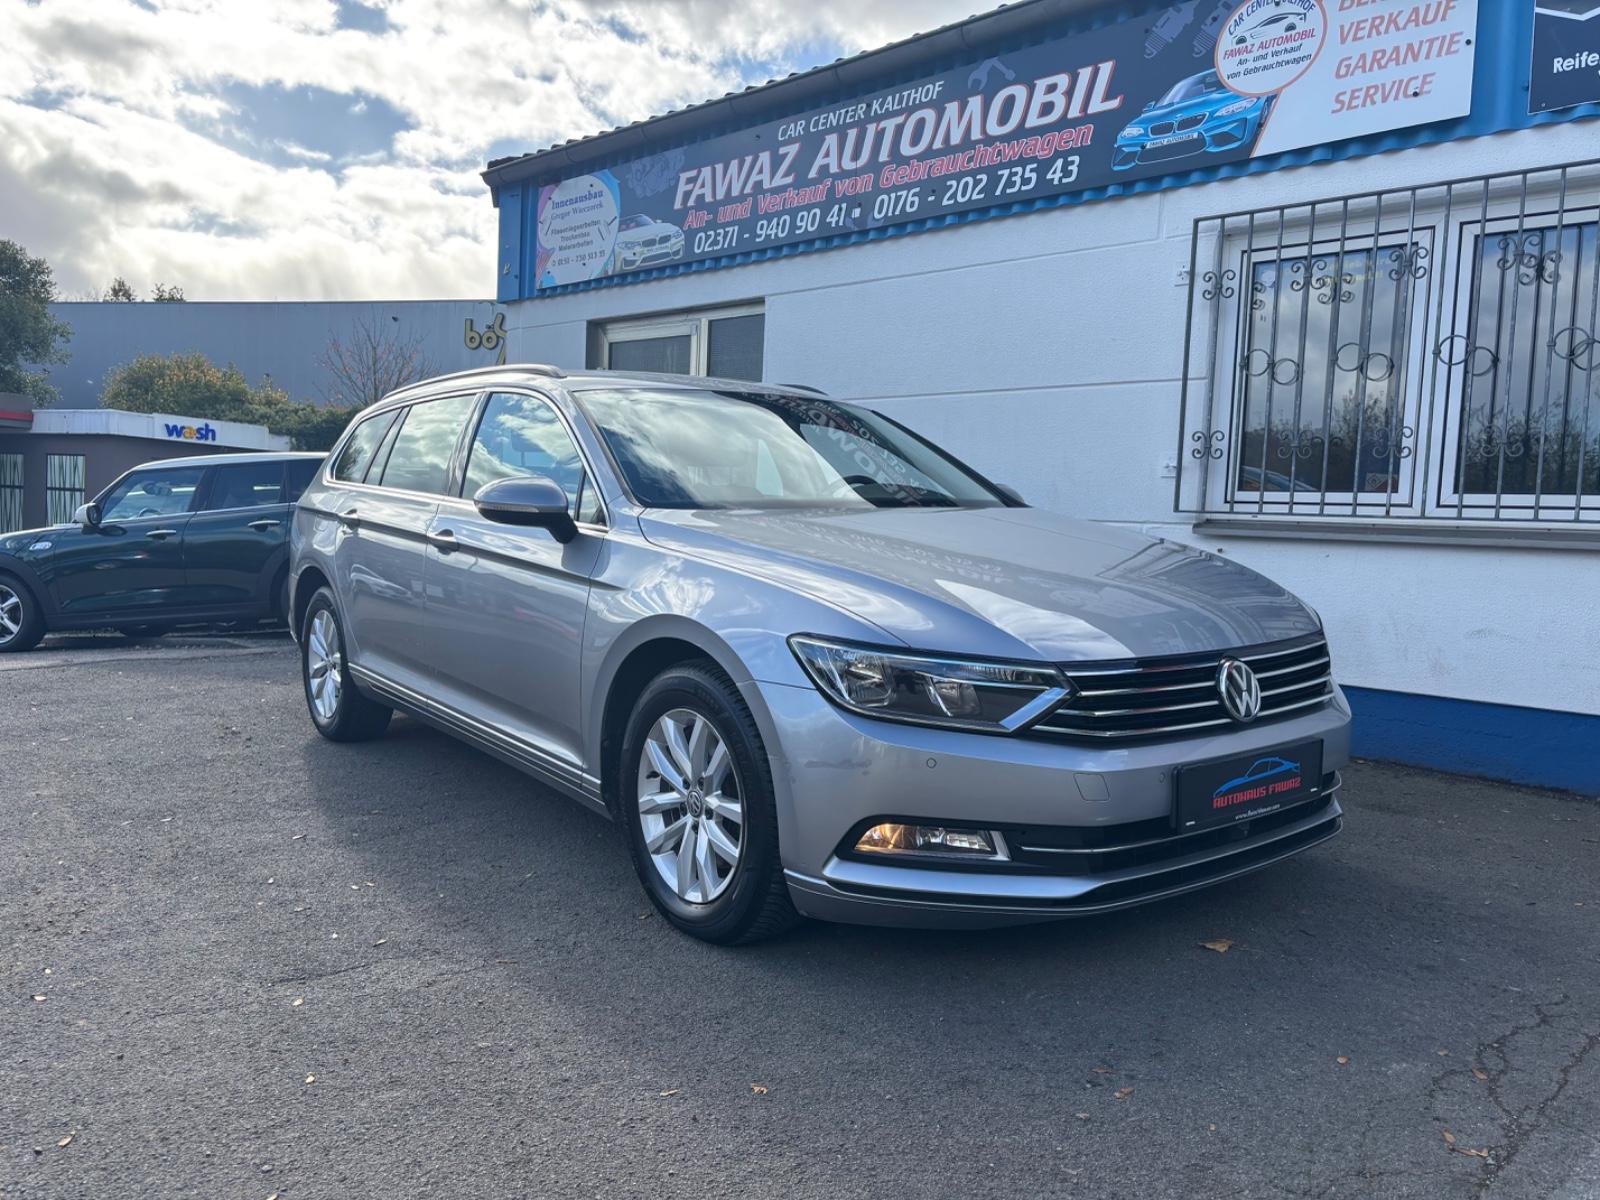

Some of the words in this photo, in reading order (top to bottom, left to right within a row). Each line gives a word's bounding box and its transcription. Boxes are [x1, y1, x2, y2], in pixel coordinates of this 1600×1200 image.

[1228, 14, 1245, 36] CAR
[1338, 0, 1457, 45] VERKAUF
[1223, 43, 1255, 60] FAWAZ
[1257, 28, 1316, 52] AUTOMOBIL
[1252, 51, 1268, 62] und
[1271, 43, 1303, 58] Verkauf
[1335, 31, 1464, 80] GARANTIE
[1553, 51, 1600, 74] Reife
[1226, 71, 1241, 81] von
[1243, 53, 1312, 76] Gebrauchtwagen
[778, 120, 805, 141] CAR
[809, 103, 867, 132] CENTER
[870, 81, 945, 116] KALTHOF
[1331, 72, 1436, 114] SERVICE
[673, 142, 801, 210] FAWAZ
[807, 59, 1124, 180] AUTOMOBIL
[683, 208, 713, 231] An-
[717, 198, 753, 224] und
[757, 178, 831, 215] Verkauf
[834, 173, 875, 198] von
[879, 123, 1095, 189] Gebrauchtwagen
[873, 187, 921, 220] 0176
[942, 174, 988, 206] 202
[994, 163, 1038, 196] 735
[1046, 155, 1080, 185] 43
[551, 190, 603, 209] Innenausbau
[694, 226, 739, 254] 02371
[755, 215, 790, 242] 940
[795, 207, 821, 234] 90
[826, 202, 848, 227] 41
[1212, 786, 1267, 809] AUTOHAUS
[1268, 777, 1302, 795] FAWAZ
